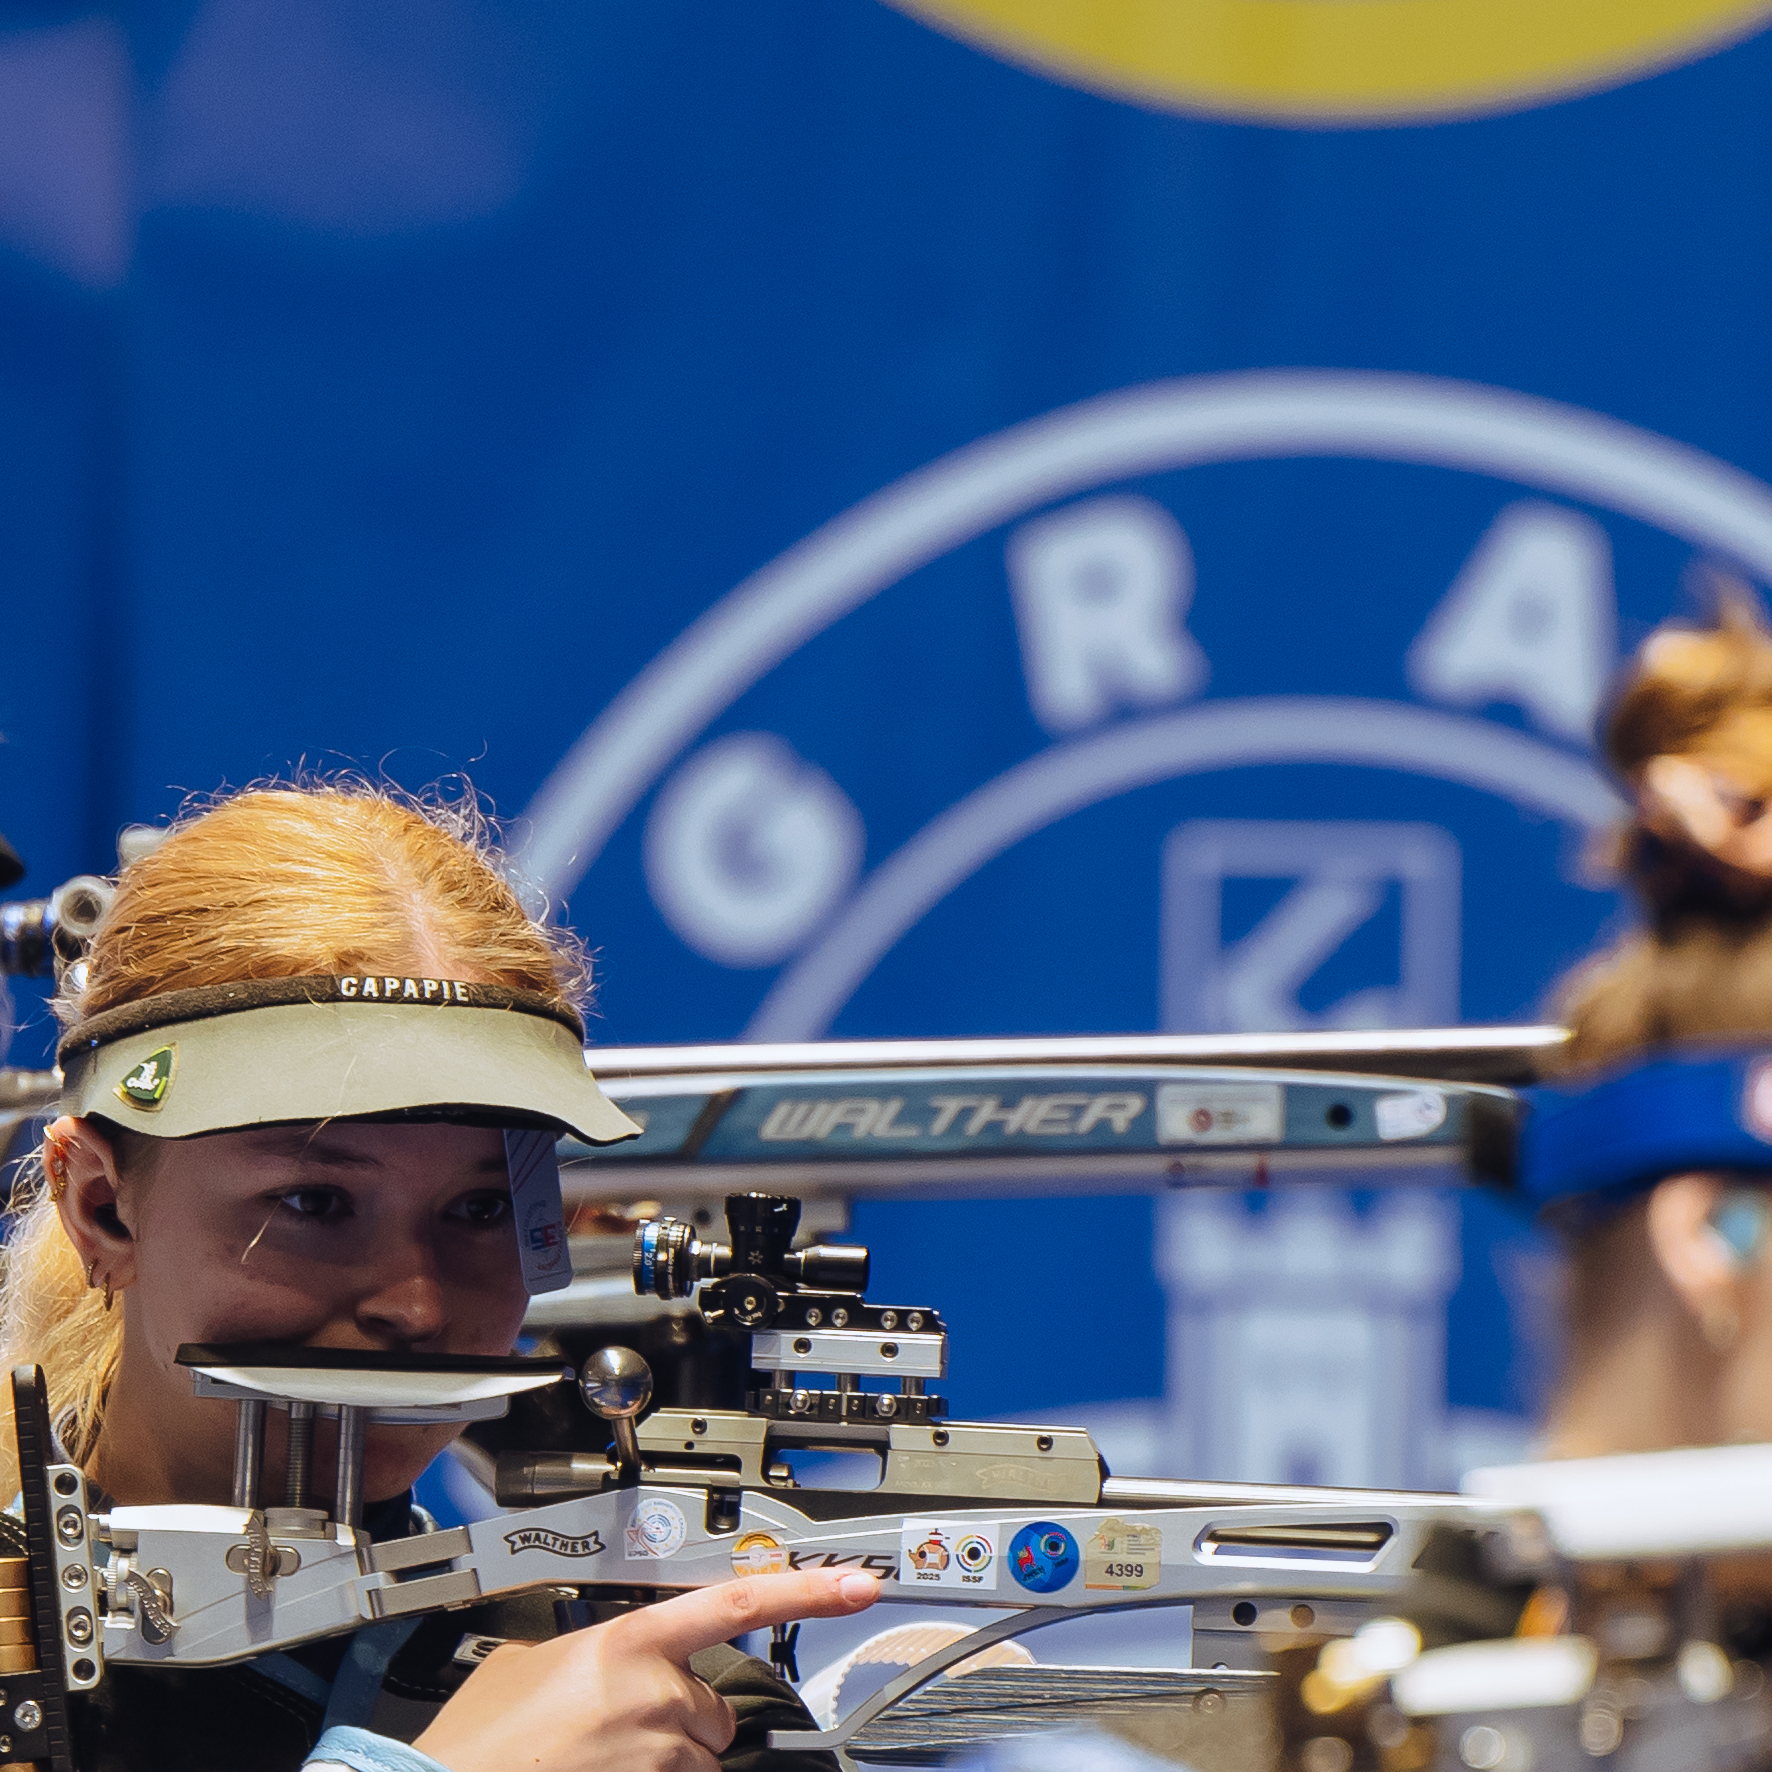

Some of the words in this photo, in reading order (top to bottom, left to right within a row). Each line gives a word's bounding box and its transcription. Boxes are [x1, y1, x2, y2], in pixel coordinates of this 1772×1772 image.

[340, 976, 469, 1002] CAPAPIE
[759, 1091, 1147, 1143] WALTHER
[518, 1532, 591, 1553] WALTHER
[1104, 1563, 1144, 1578] 4399
